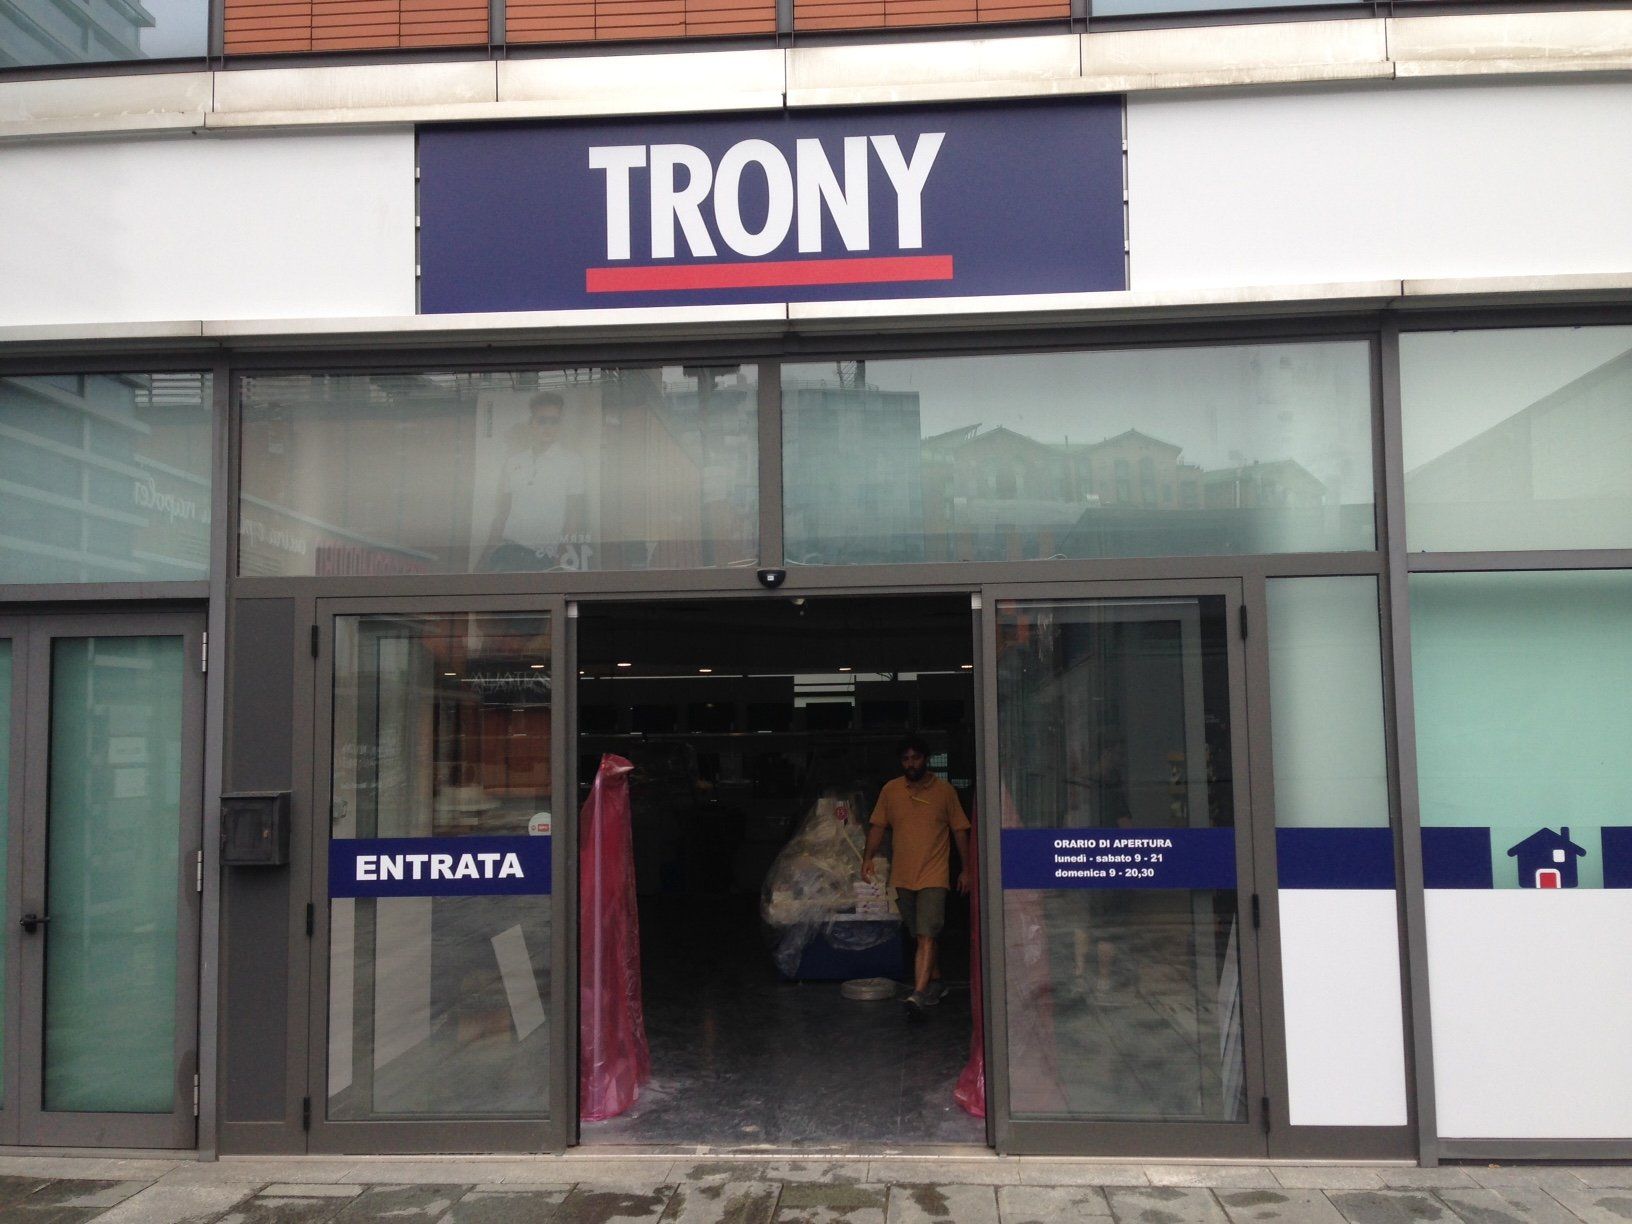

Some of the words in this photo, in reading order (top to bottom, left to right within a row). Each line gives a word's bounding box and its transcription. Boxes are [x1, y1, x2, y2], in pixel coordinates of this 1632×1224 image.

[588, 132, 946, 260] TRONY
[1053, 839, 1097, 849] ORARIO
[1099, 839, 1111, 848] DI
[1113, 839, 1173, 848] APERTURA
[1095, 853, 1132, 863] sabato
[1134, 853, 1142, 863] 9
[1150, 853, 1163, 863] 21
[356, 853, 525, 881] ENTRATA
[1054, 868, 1107, 878] domenica
[1108, 868, 1117, 878] 9
[1124, 868, 1155, 879] 20,30
